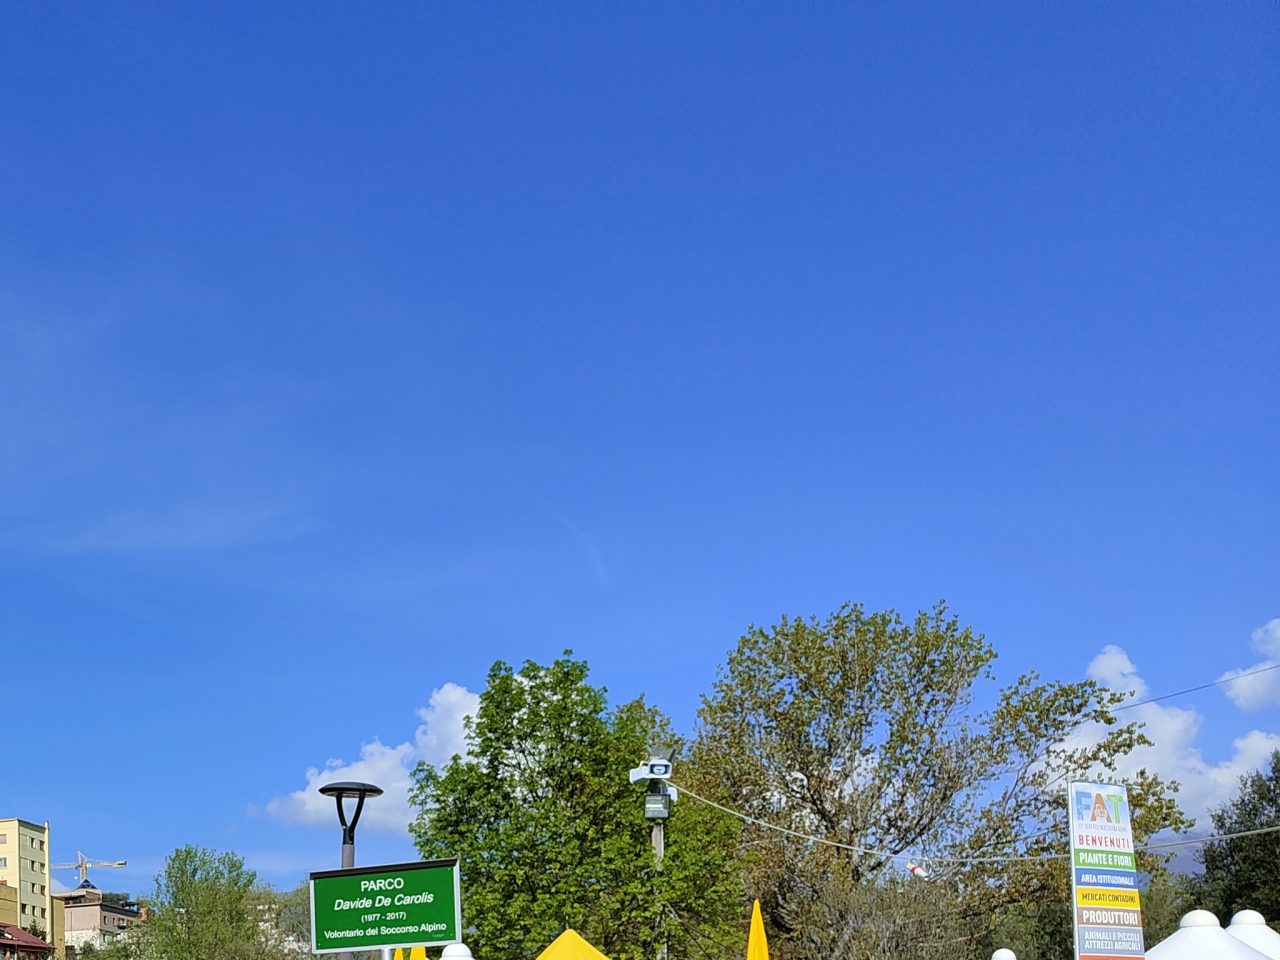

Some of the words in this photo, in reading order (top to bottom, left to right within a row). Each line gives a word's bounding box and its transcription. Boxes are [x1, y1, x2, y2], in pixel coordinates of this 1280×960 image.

[1076, 791, 1124, 824] FAT
[1078, 834, 1130, 849] BENVENUTI
[1079, 852, 1107, 865] PIANTE
[1108, 854, 1114, 865] E
[1114, 854, 1132, 867] FIORI
[360, 877, 404, 892] PARCO
[1081, 874, 1097, 883] AREA
[1097, 875, 1134, 886] ISTITUZIONALE
[334, 896, 373, 911] Davide
[374, 896, 391, 908] De
[393, 891, 435, 906] Carolis
[1082, 892, 1107, 902] MERCATI
[1108, 894, 1136, 903] CONTADINI
[361, 913, 380, 924] (1977
[386, 911, 407, 921] 2017)
[1083, 910, 1138, 926] PRODUTTORI
[324, 928, 364, 940] Volontario
[365, 927, 379, 937] del
[380, 925, 419, 935] Soccorso
[420, 922, 448, 933] Alpino
[1084, 930, 1112, 940] ANIMALI
[1113, 932, 1118, 940] E
[1118, 932, 1140, 941] PICCOLI
[1085, 941, 1114, 950] ATTREZZI
[1115, 941, 1140, 951] AGRICOLI
